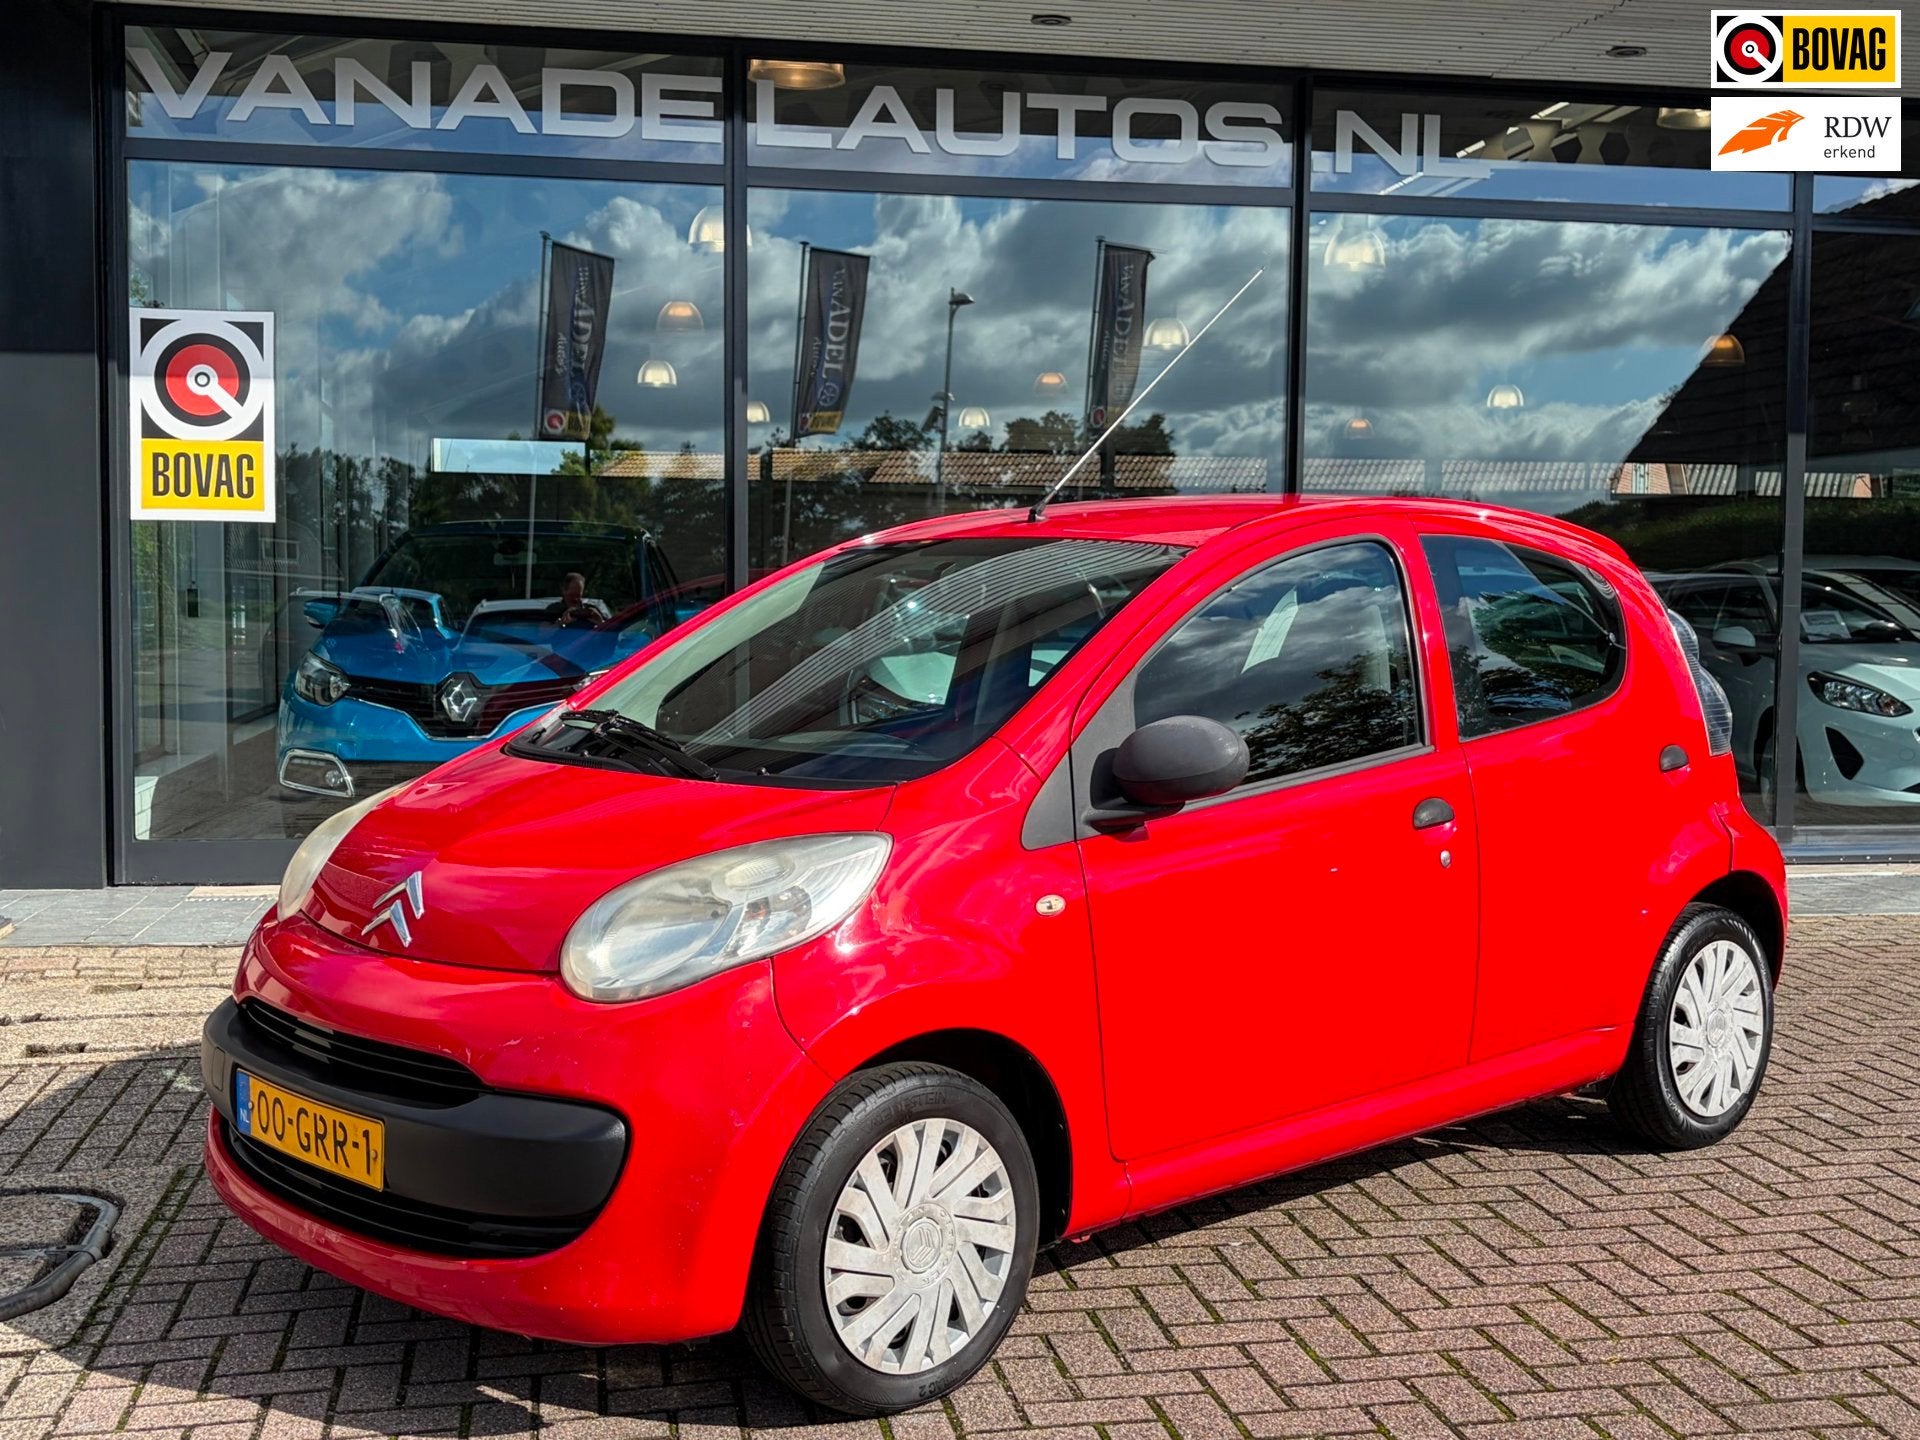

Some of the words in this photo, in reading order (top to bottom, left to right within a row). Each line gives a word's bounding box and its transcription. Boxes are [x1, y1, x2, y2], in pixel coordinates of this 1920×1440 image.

[152, 452, 254, 499] BOVAG
[240, 1107, 249, 1123] NL
[257, 1089, 371, 1176] 00-GRR-1
